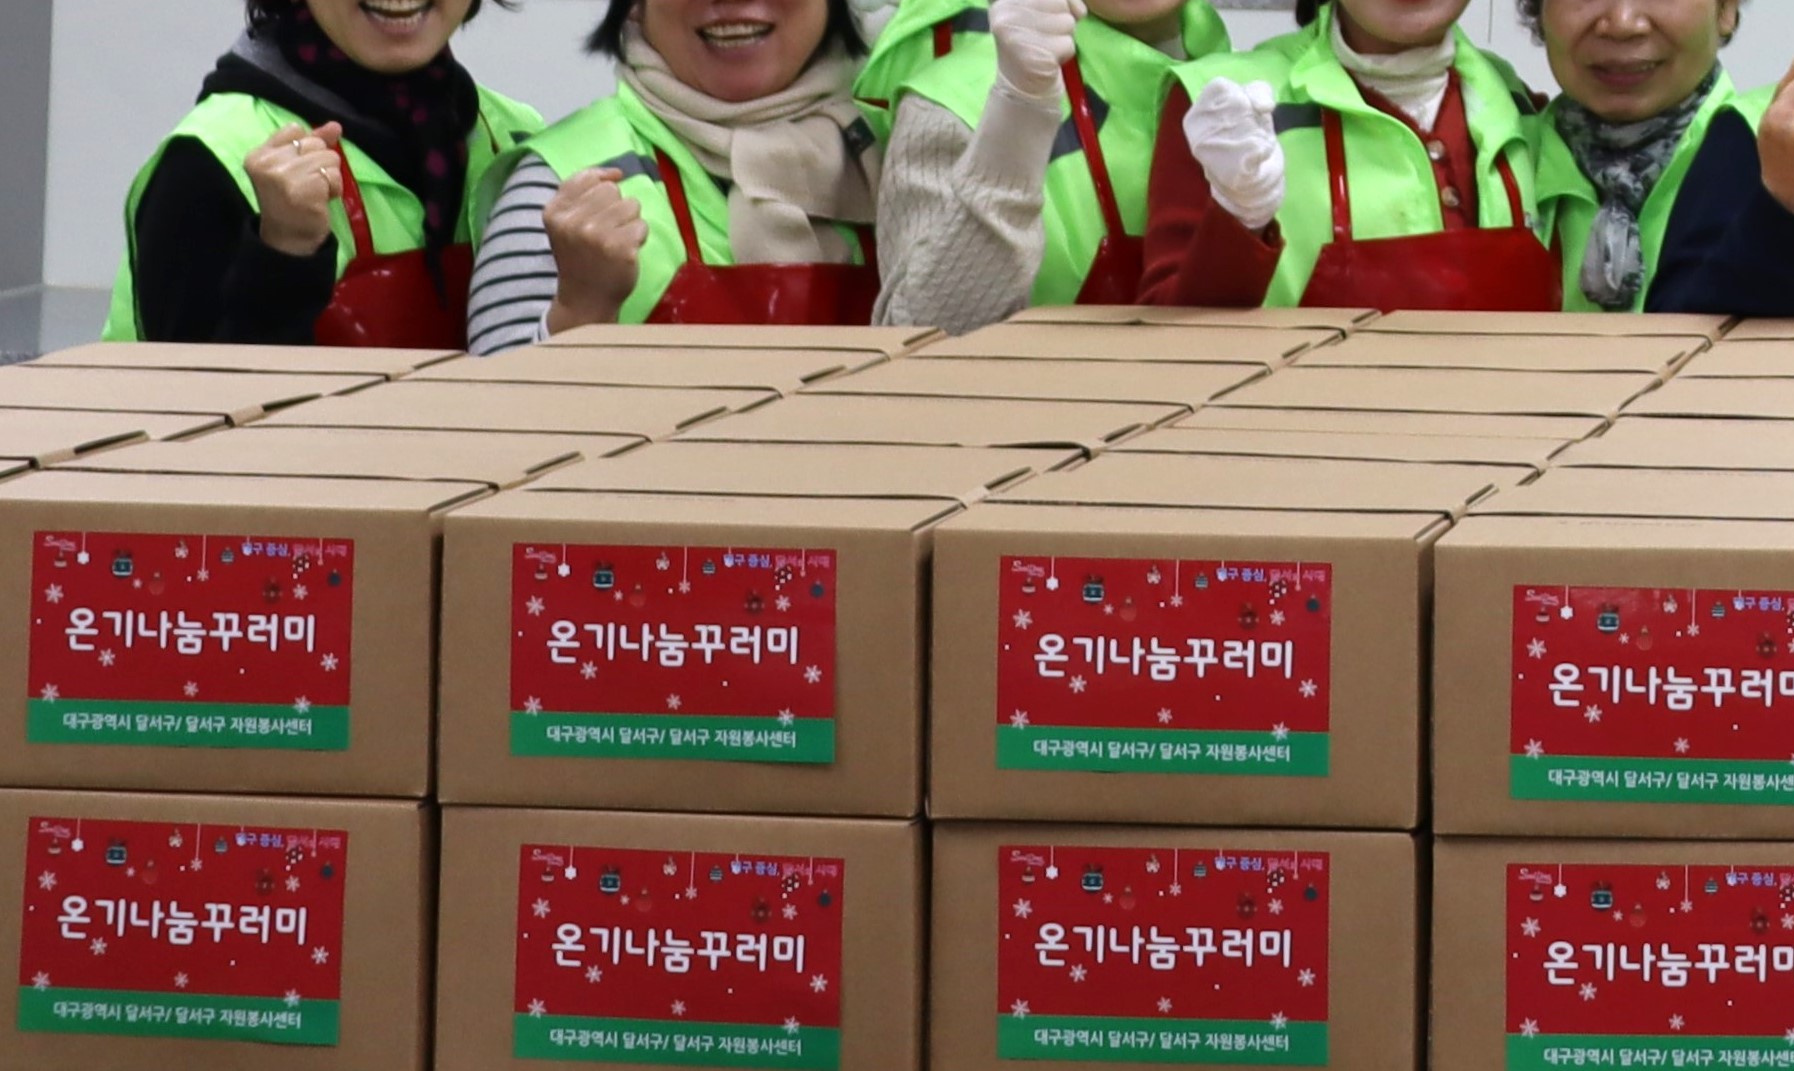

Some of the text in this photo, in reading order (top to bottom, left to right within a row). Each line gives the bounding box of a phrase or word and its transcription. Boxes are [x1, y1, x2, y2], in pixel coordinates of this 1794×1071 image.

[65, 607, 315, 655] 온기나눔꾸러미
[546, 620, 798, 668] 온기나눔꾸러미
[1033, 633, 1293, 681] 온기나눔꾸러미
[63, 711, 312, 736] 대구광역시 달서구/ 달서구 자원봉사센터
[546, 724, 797, 748] 대구광역시 달서구/ 달서구 자원봉사센터
[1033, 738, 1291, 763] 대구광역시 달서구/ 달서구 자원봉사센터
[1548, 768, 1619, 787] 대구광역시
[1624, 769, 1672, 789] 달서구/
[1676, 771, 1719, 790] 달서구
[57, 895, 307, 945] 온기나눔꾸러미
[551, 923, 805, 973] 온기나눔꾸러미
[1034, 922, 1291, 970] 온기나눔꾸러미
[53, 999, 301, 1030] 대구광역시 달서구/ 달서구 자원봉사센터
[549, 1027, 802, 1057] 대구광역시 달서구/ 달서구 자원봉사센터
[1034, 1027, 1289, 1052] 대구광역시 달서구/ 달서구 자원봉사센터
[1543, 1046, 1614, 1065] 대구광역시
[1619, 1047, 1667, 1066] 달서구/
[1672, 1048, 1714, 1066] 달서구
